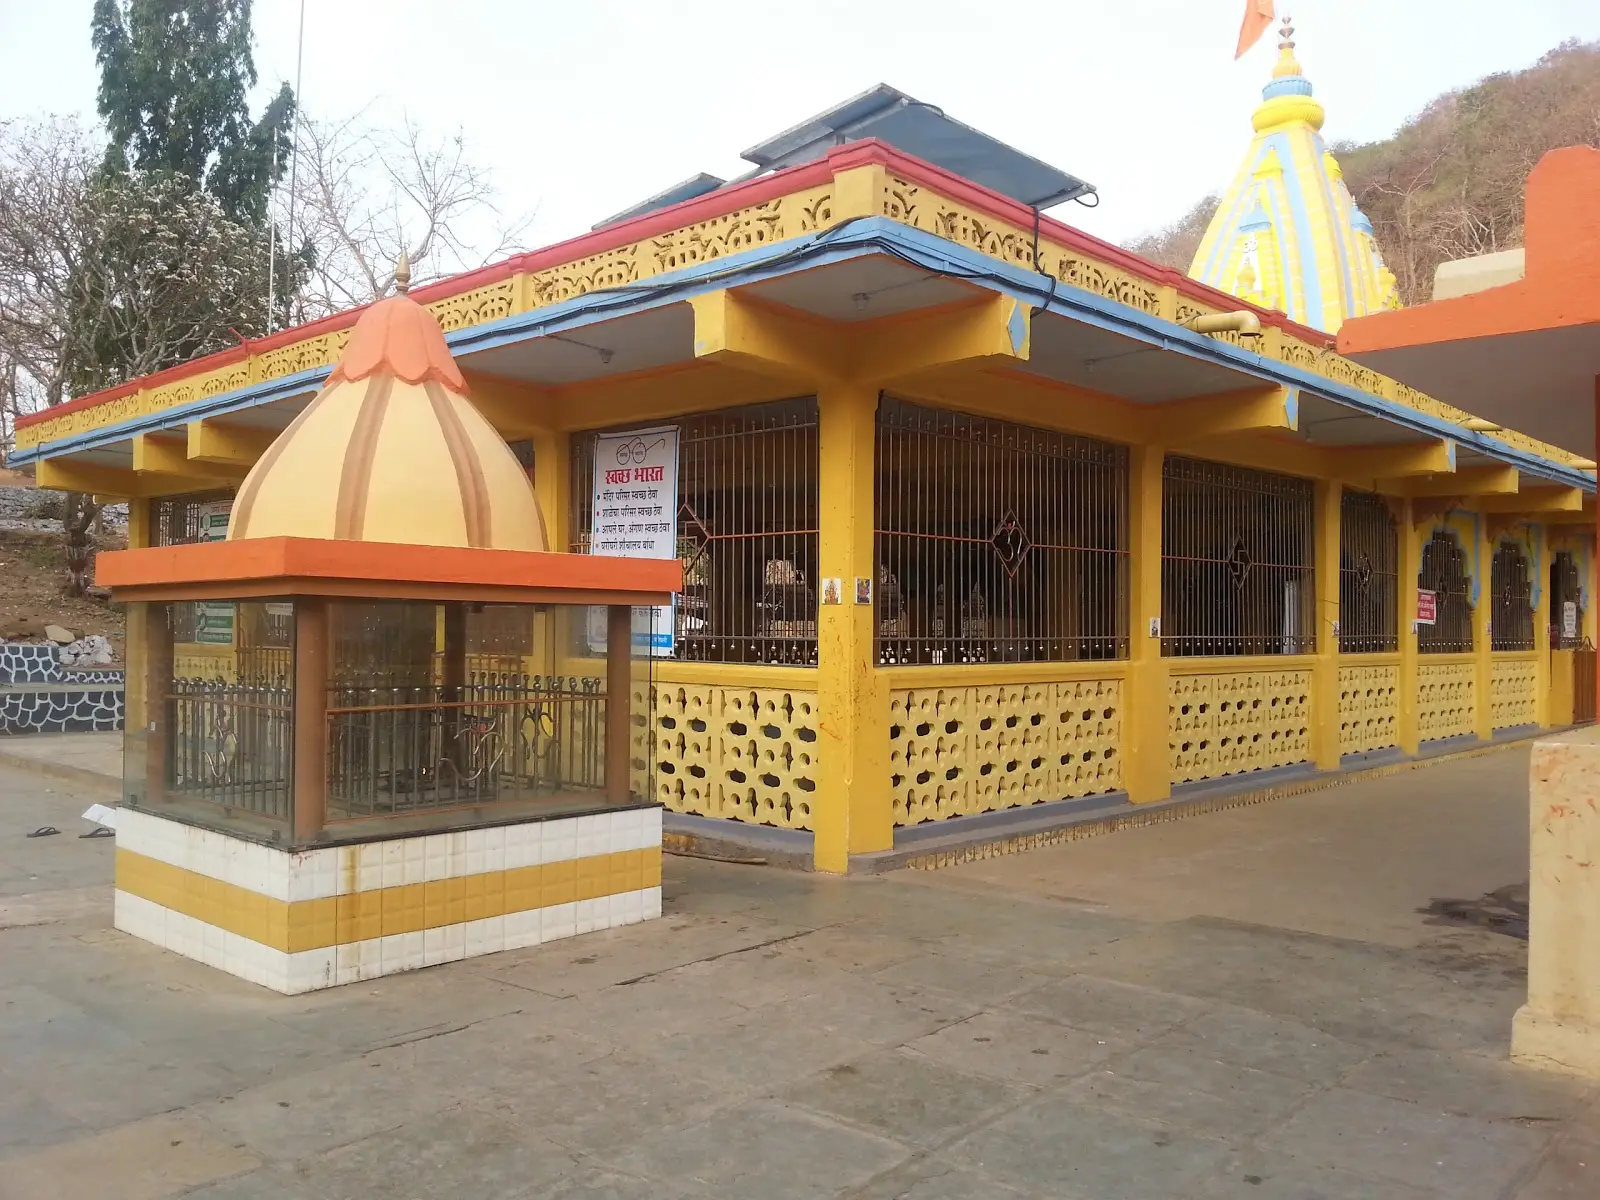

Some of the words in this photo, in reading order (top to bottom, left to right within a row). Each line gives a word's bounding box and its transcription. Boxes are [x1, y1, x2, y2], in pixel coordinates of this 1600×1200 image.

[605, 469, 632, 485] स्वच्छ
[634, 466, 665, 483] भारत
[632, 490, 647, 501] स्वच्छ
[648, 486, 659, 500] ठेवा
[638, 507, 653, 518] स्वच्छ
[653, 503, 663, 517] ठेवा
[602, 521, 617, 535] आपले
[645, 524, 659, 535] स्वच्छ
[659, 520, 671, 534] ठेवा
